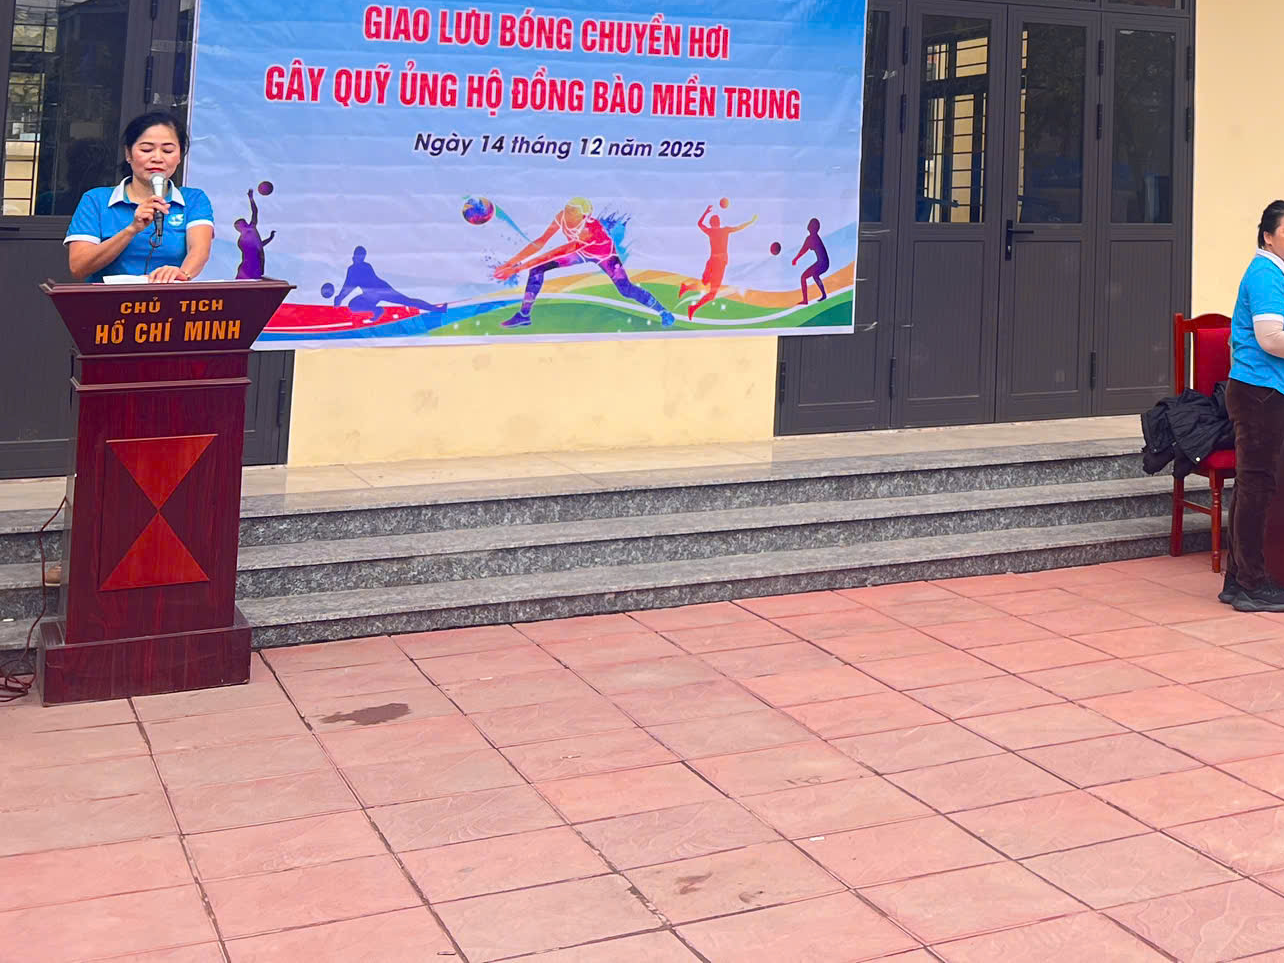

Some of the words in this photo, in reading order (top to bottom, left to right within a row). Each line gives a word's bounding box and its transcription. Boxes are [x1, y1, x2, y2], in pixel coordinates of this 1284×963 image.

[365, 6, 430, 42] GIAO
[439, 9, 491, 45] LƯU
[500, 9, 572, 50] BÓNG
[581, 14, 681, 57] CHUYỀN
[689, 24, 729, 59] HƠI
[265, 59, 325, 101] GÂY
[334, 64, 392, 107] QUỸ
[400, 61, 457, 107] ỦNG
[467, 69, 503, 116] HỘ
[511, 67, 584, 112] ĐỒNG
[593, 75, 643, 114] BÀO
[652, 75, 716, 117] MIỀN
[724, 87, 800, 119] TRUNG
[414, 133, 473, 156] Ngày
[481, 136, 504, 152] 14
[511, 136, 571, 159] tháng
[580, 138, 603, 155] 12
[608, 139, 652, 156] năm
[658, 141, 705, 157] 2025
[120, 297, 161, 314] CHỦ
[180, 299, 223, 314] TỊCH
[95, 318, 125, 344] HỒ
[135, 318, 173, 343] CHÍ
[184, 320, 241, 341] MINH
